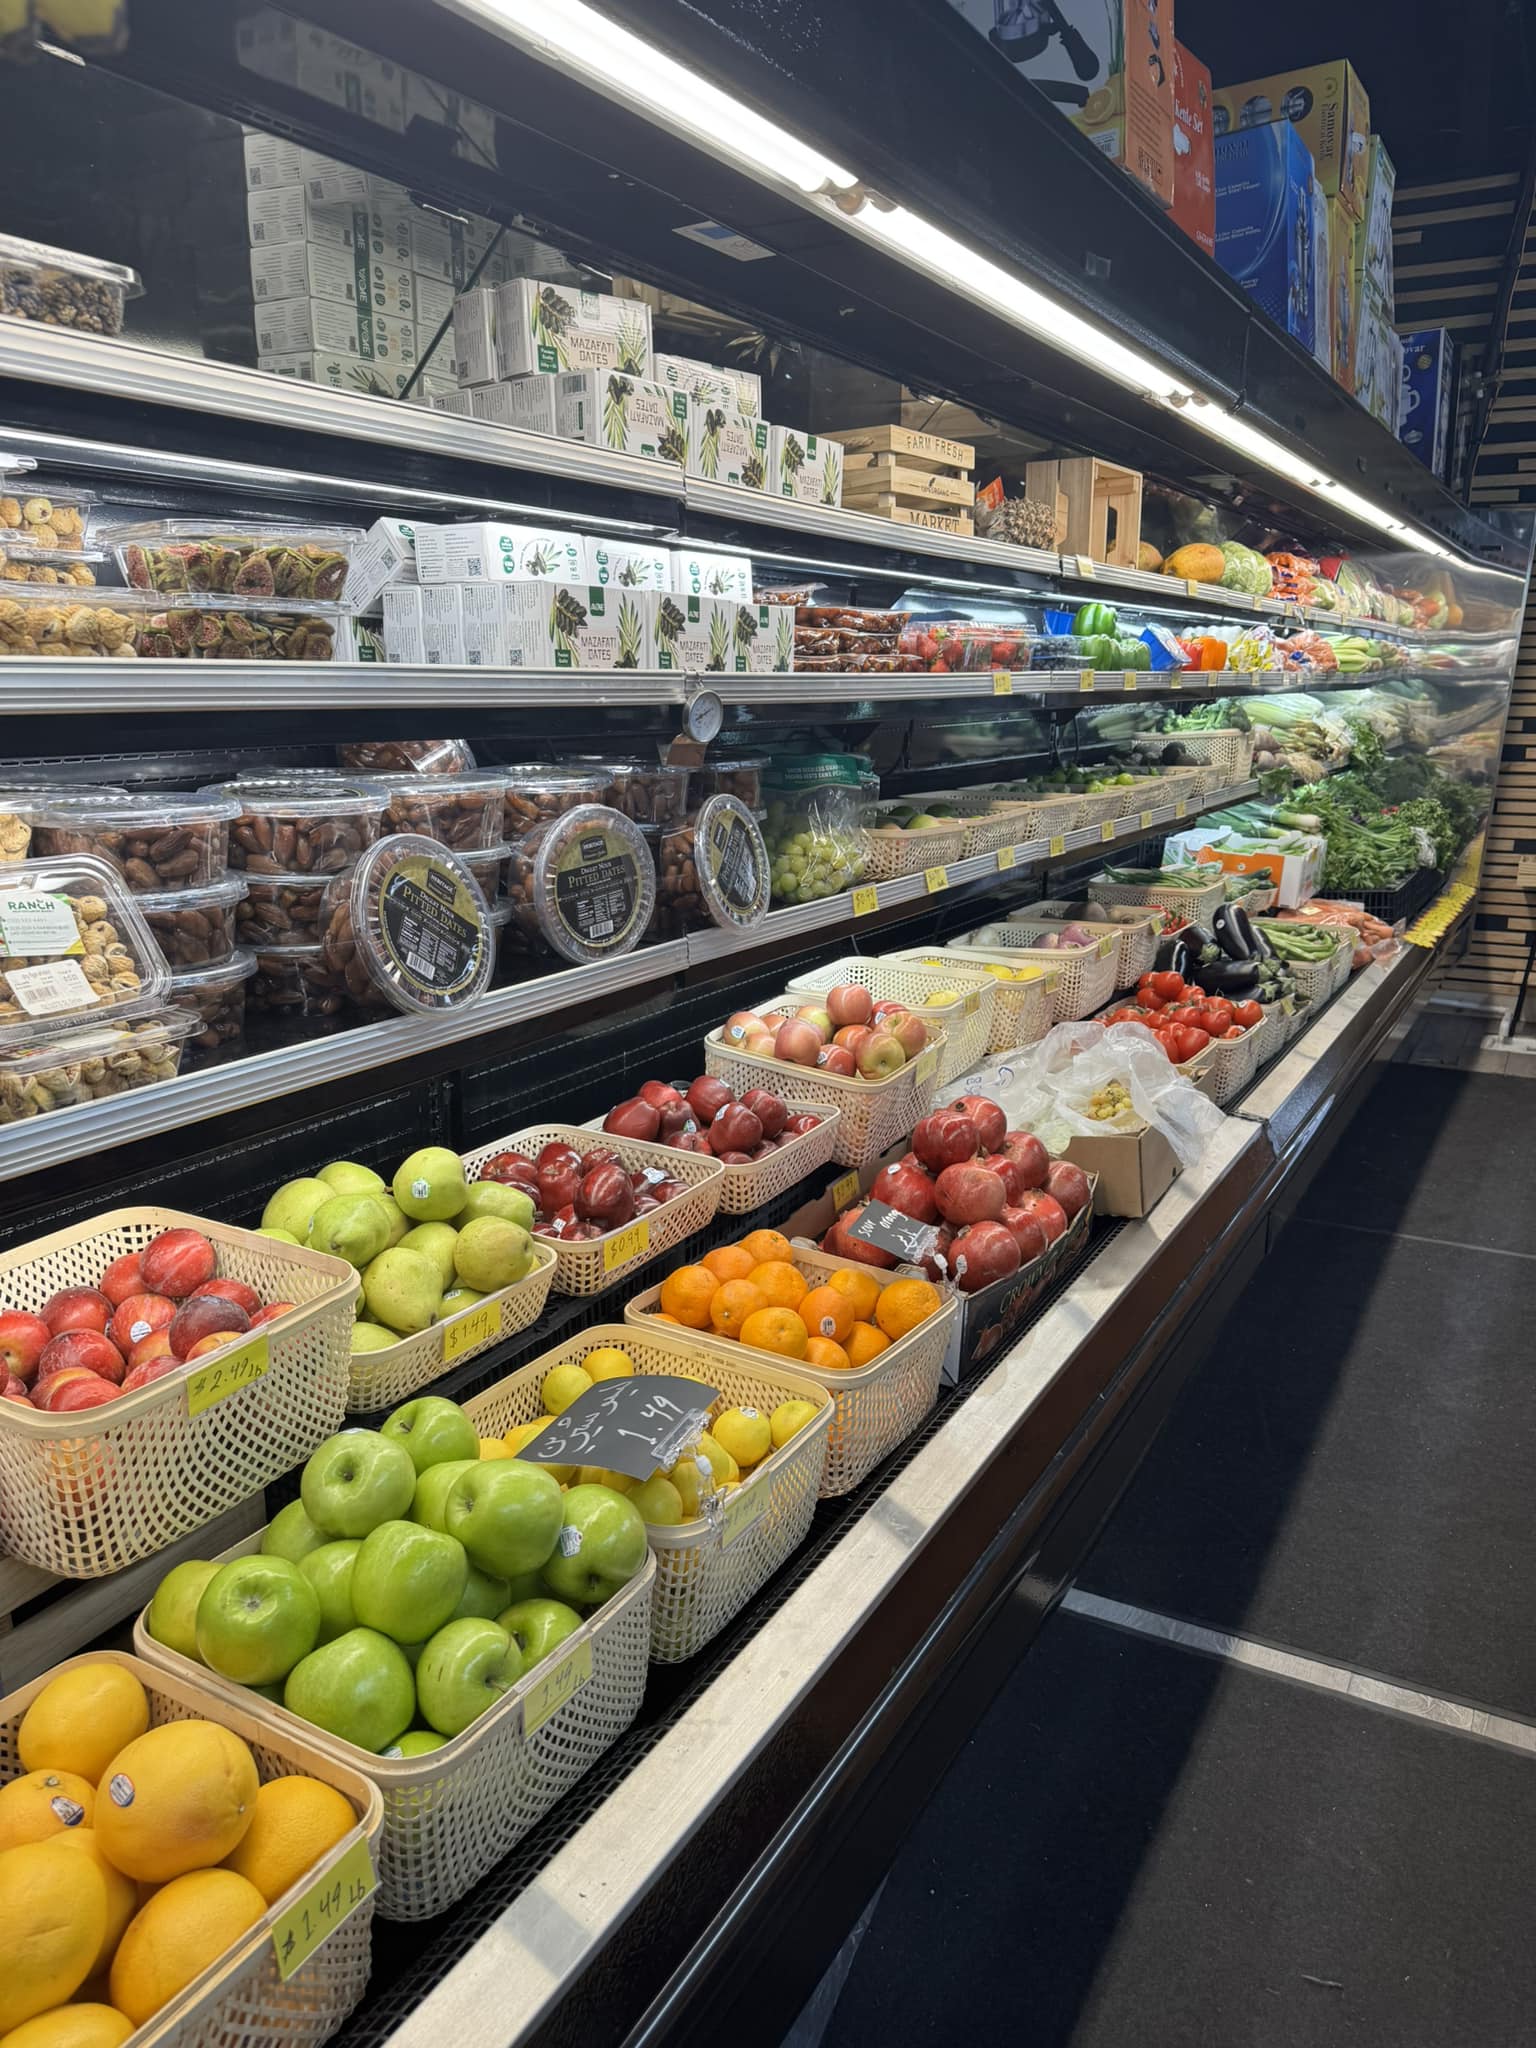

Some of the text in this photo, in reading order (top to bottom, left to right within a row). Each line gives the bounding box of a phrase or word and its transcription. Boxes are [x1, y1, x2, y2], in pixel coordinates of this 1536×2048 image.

[1326, 102, 1337, 160] Samovar
[569, 336, 616, 354] MAZAFATI
[578, 351, 609, 366] DATES
[635, 398, 660, 414] DATES
[629, 411, 665, 428] MAZAFATI
[726, 430, 745, 444] DATES
[906, 435, 964, 463] FARM FRESH
[802, 486, 819, 499] DATES
[909, 511, 960, 534] MARKET
[580, 636, 617, 649] MAZAFATI
[679, 640, 709, 653] MAZAFATI
[587, 648, 612, 662] DATES
[685, 651, 705, 665] DATES
[756, 654, 773, 666] DATES
[567, 864, 626, 889] PITTED DATES
[8, 901, 56, 911] RANCH
[403, 886, 440, 920] PITTED
[440, 914, 468, 939] DATES
[858, 1219, 877, 1238] Sour
[449, 1311, 488, 1348] $1.49
[617, 1395, 685, 1446] 1.49
[282, 1881, 341, 1965] $1.49
